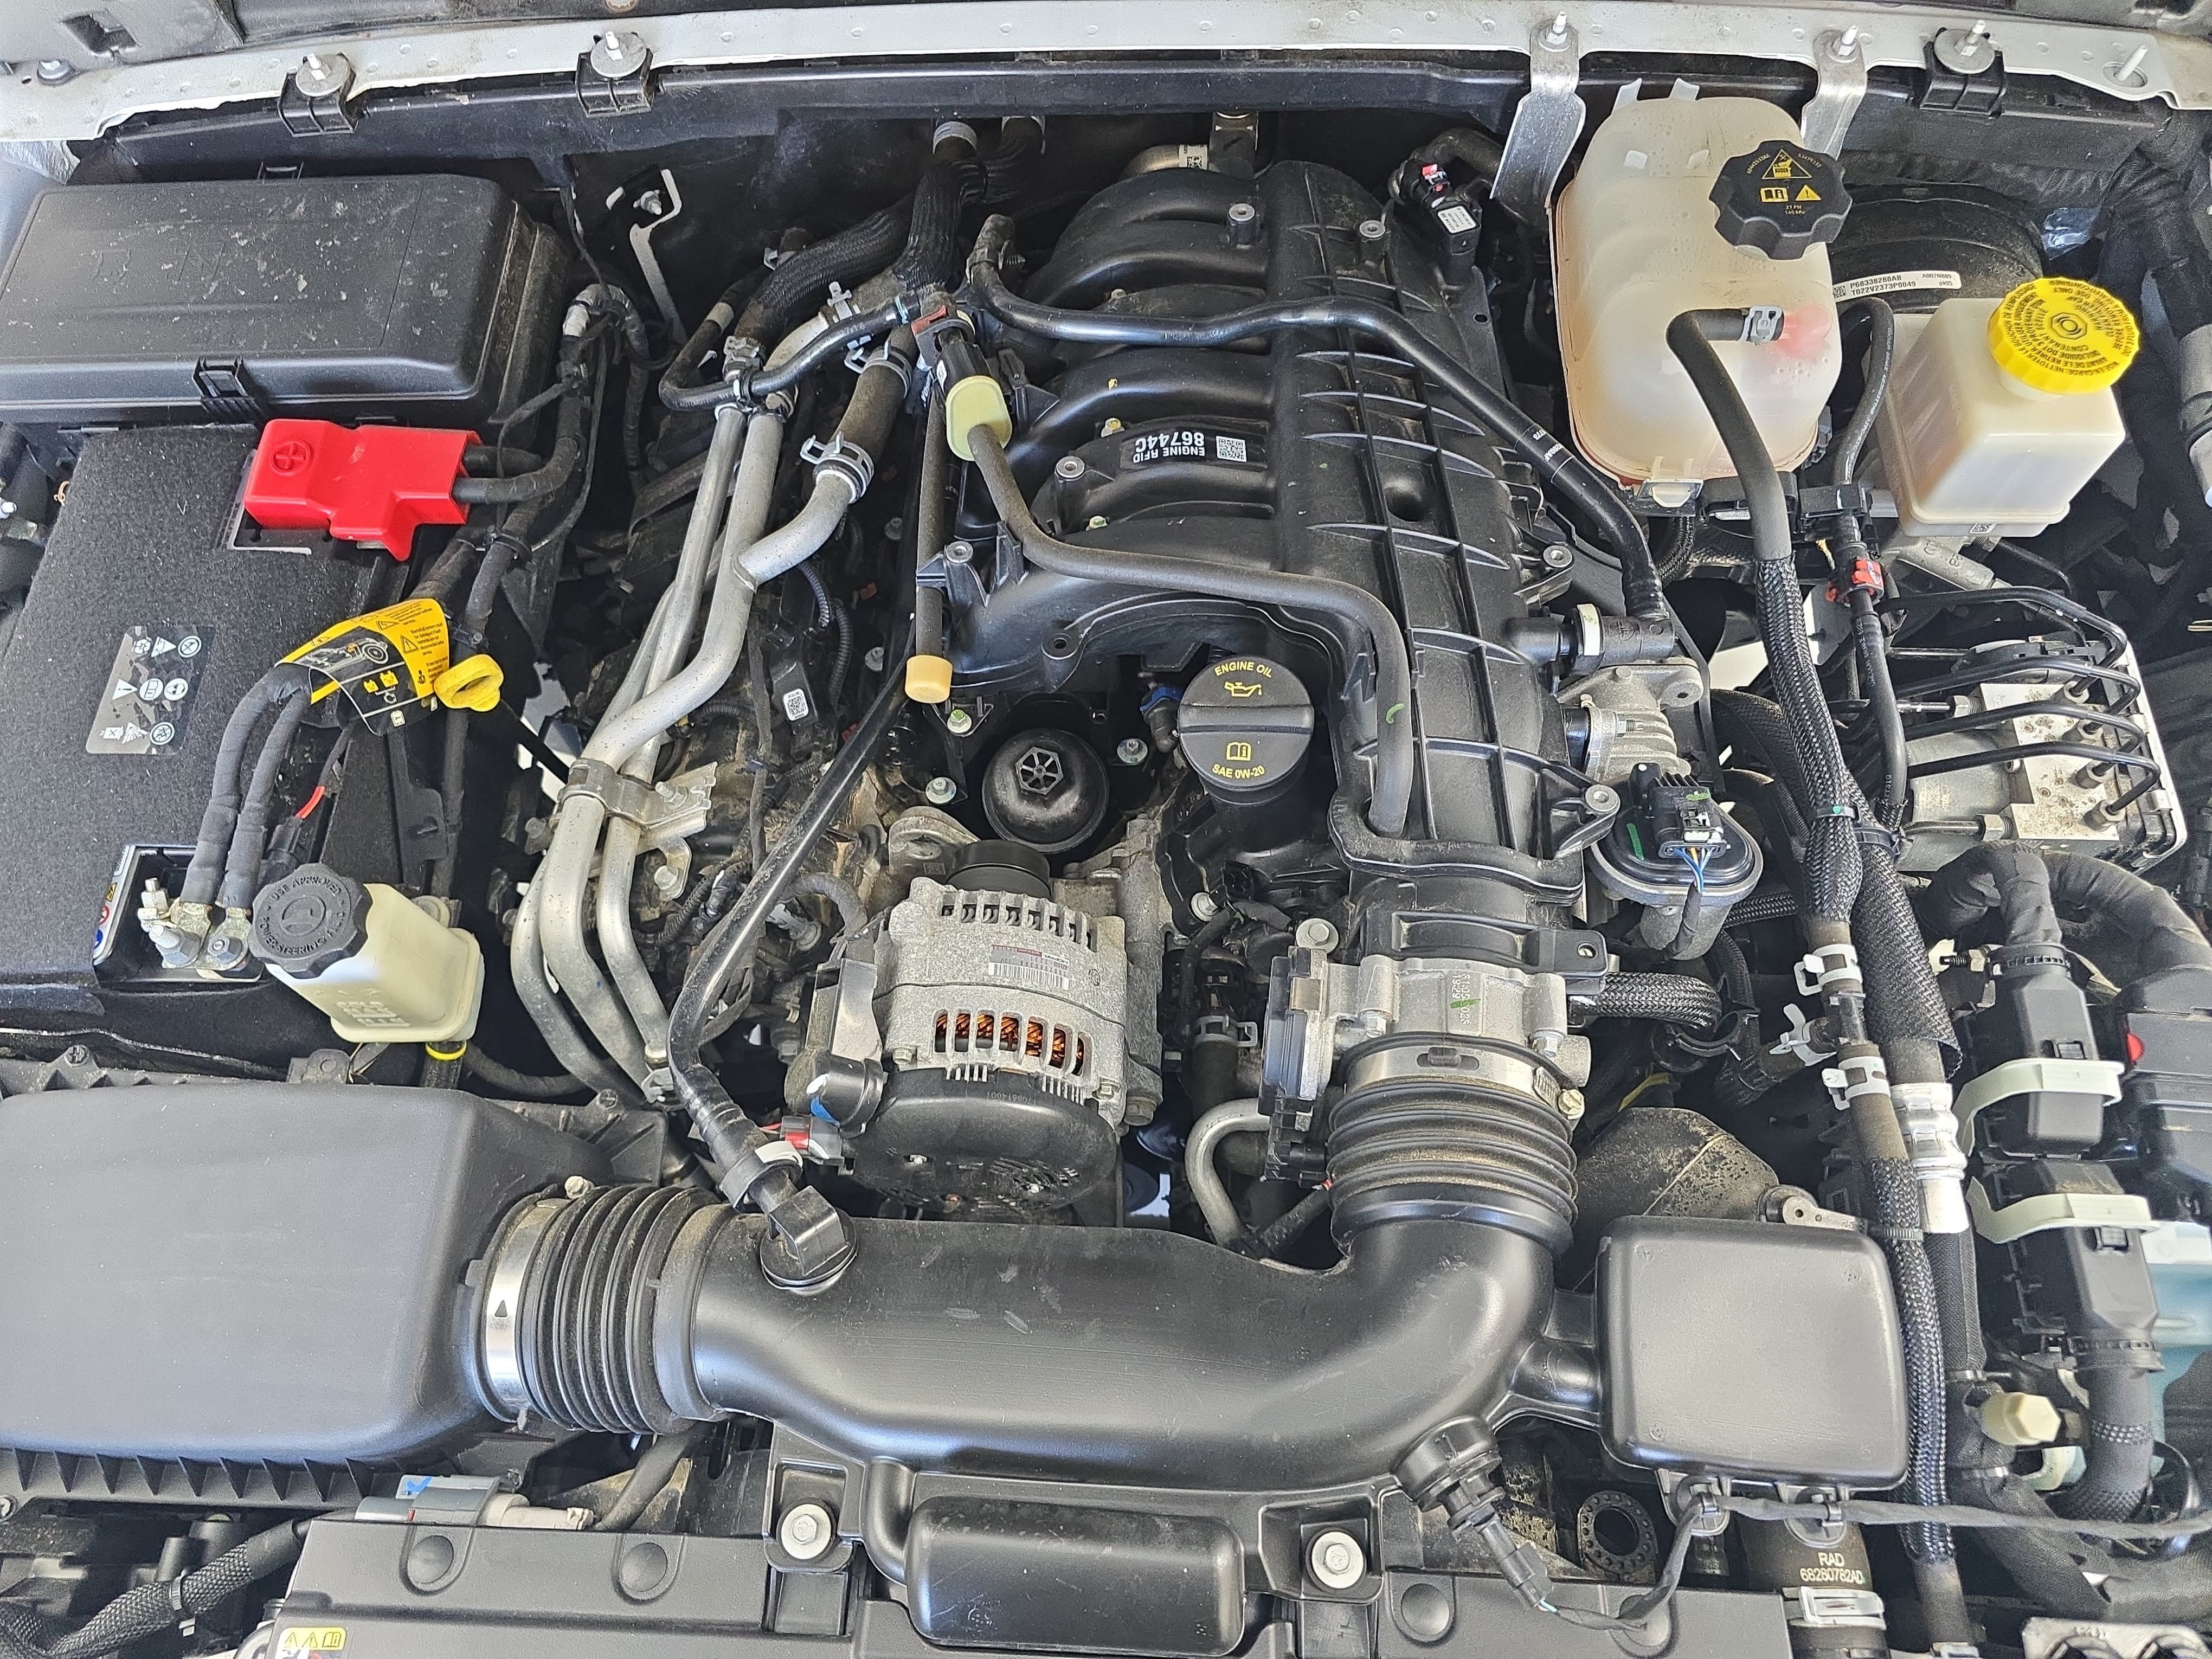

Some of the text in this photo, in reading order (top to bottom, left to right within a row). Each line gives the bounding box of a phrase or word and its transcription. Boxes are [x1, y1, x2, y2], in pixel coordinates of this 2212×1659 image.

[1851, 281, 1917, 295] T022V2373P0049
[2075, 289, 2091, 299] USE
[2024, 307, 2041, 343] PROVENANT
[2116, 308, 2131, 325] FROM
[2004, 320, 2022, 348] BOUCHON
[2014, 321, 2033, 348] UTILISER
[2039, 332, 2091, 354] CONTENANT
[2112, 328, 2124, 350] BEFORE
[2017, 346, 2029, 355] LE
[2041, 344, 2059, 357] DOT
[2120, 345, 2132, 357] DOT
[2026, 351, 2064, 375] NETTOYER
[1135, 432, 1205, 453] 86744C
[1133, 446, 1205, 464] ENGINE RFID
[1214, 661, 1272, 678] ENGINE OIL
[1212, 764, 1265, 779] SAE 0W-20
[269, 876, 342, 901] USE APPROVED
[260, 916, 278, 949] POWER
[276, 936, 326, 955] STEERING
[1818, 1552, 1845, 1567] RAD
